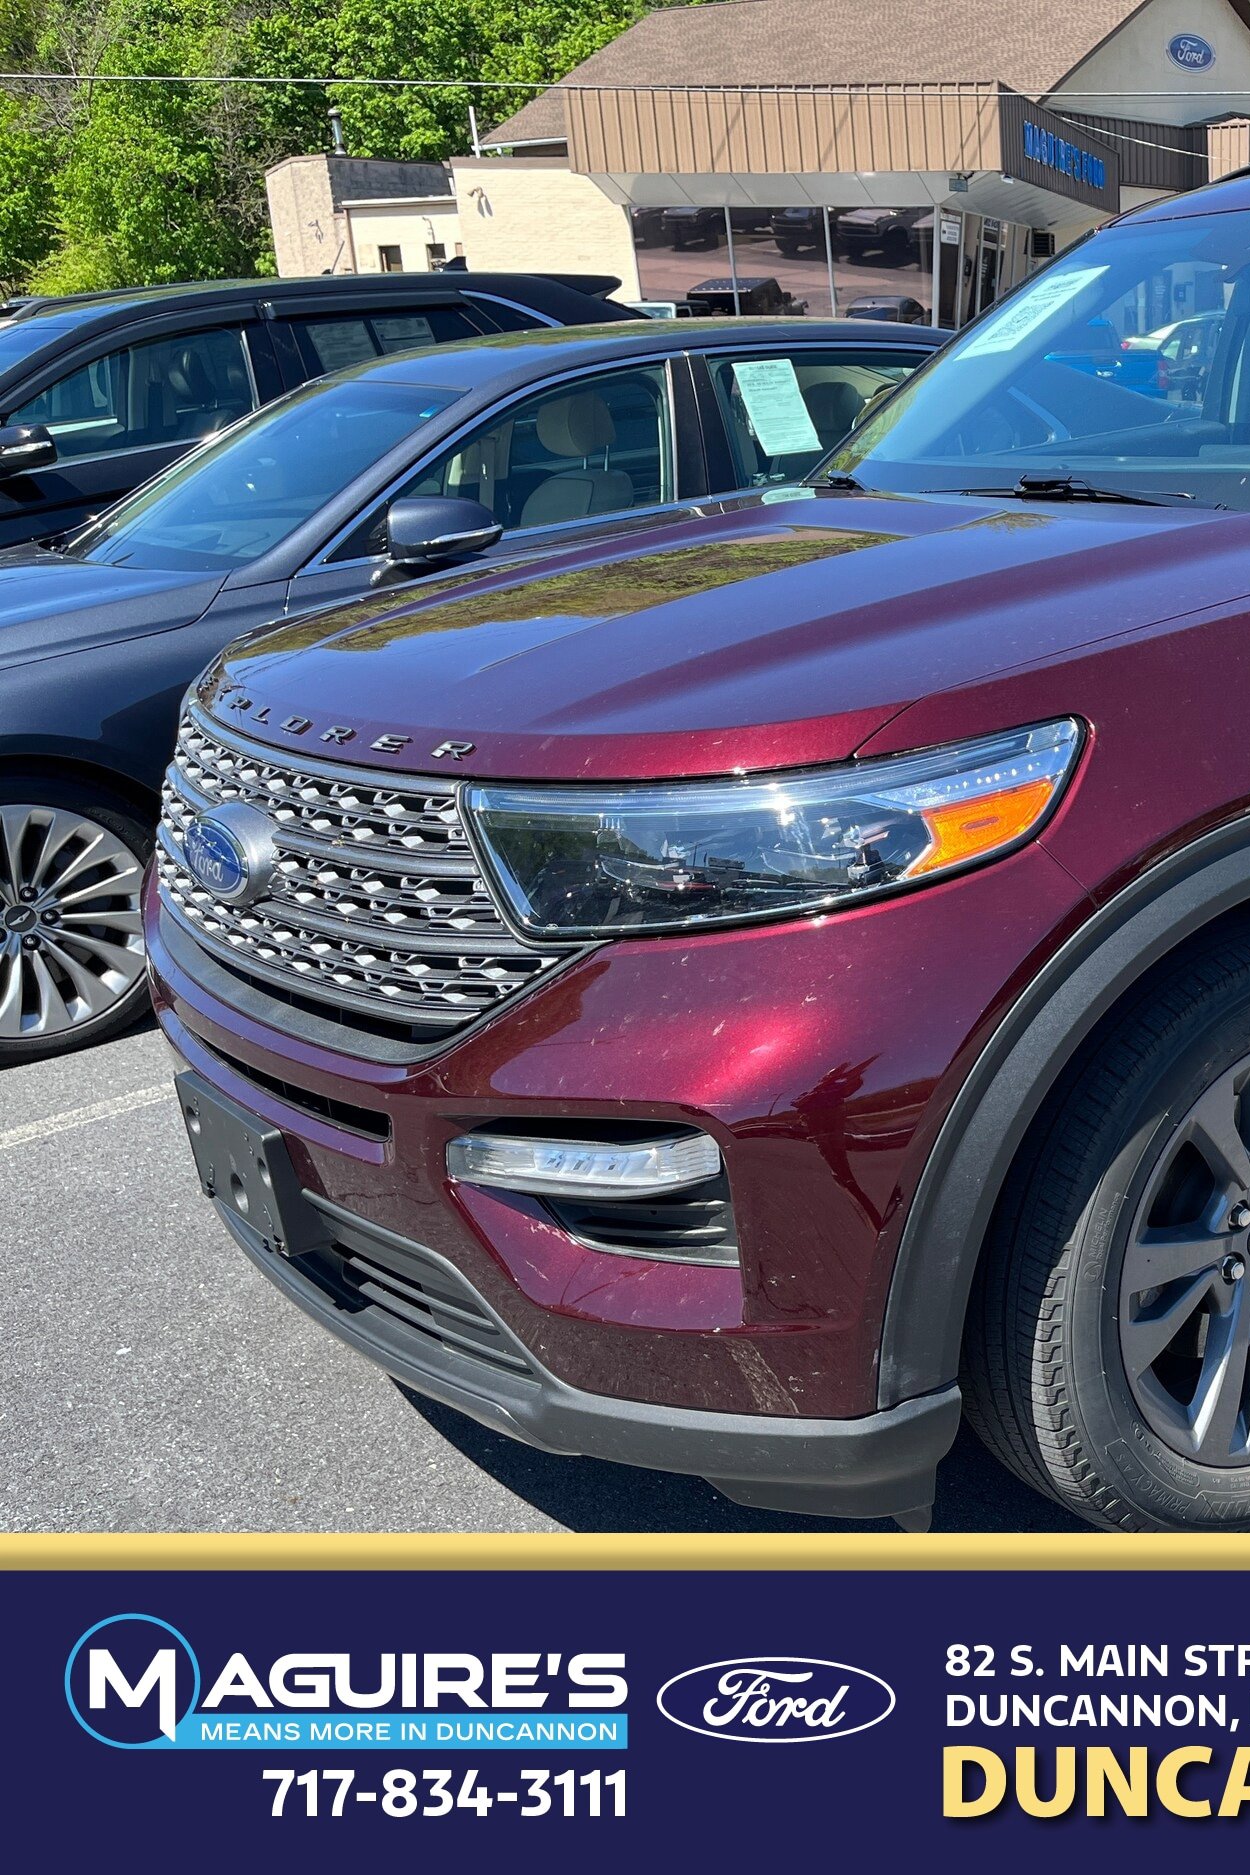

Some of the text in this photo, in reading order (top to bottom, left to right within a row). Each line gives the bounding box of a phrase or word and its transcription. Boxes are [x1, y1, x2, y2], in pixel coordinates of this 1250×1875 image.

[1178, 39, 1205, 64] Ford
[1088, 1207, 1108, 1258] MICHELIN
[1131, 1473, 1192, 1514] PRIMACY
